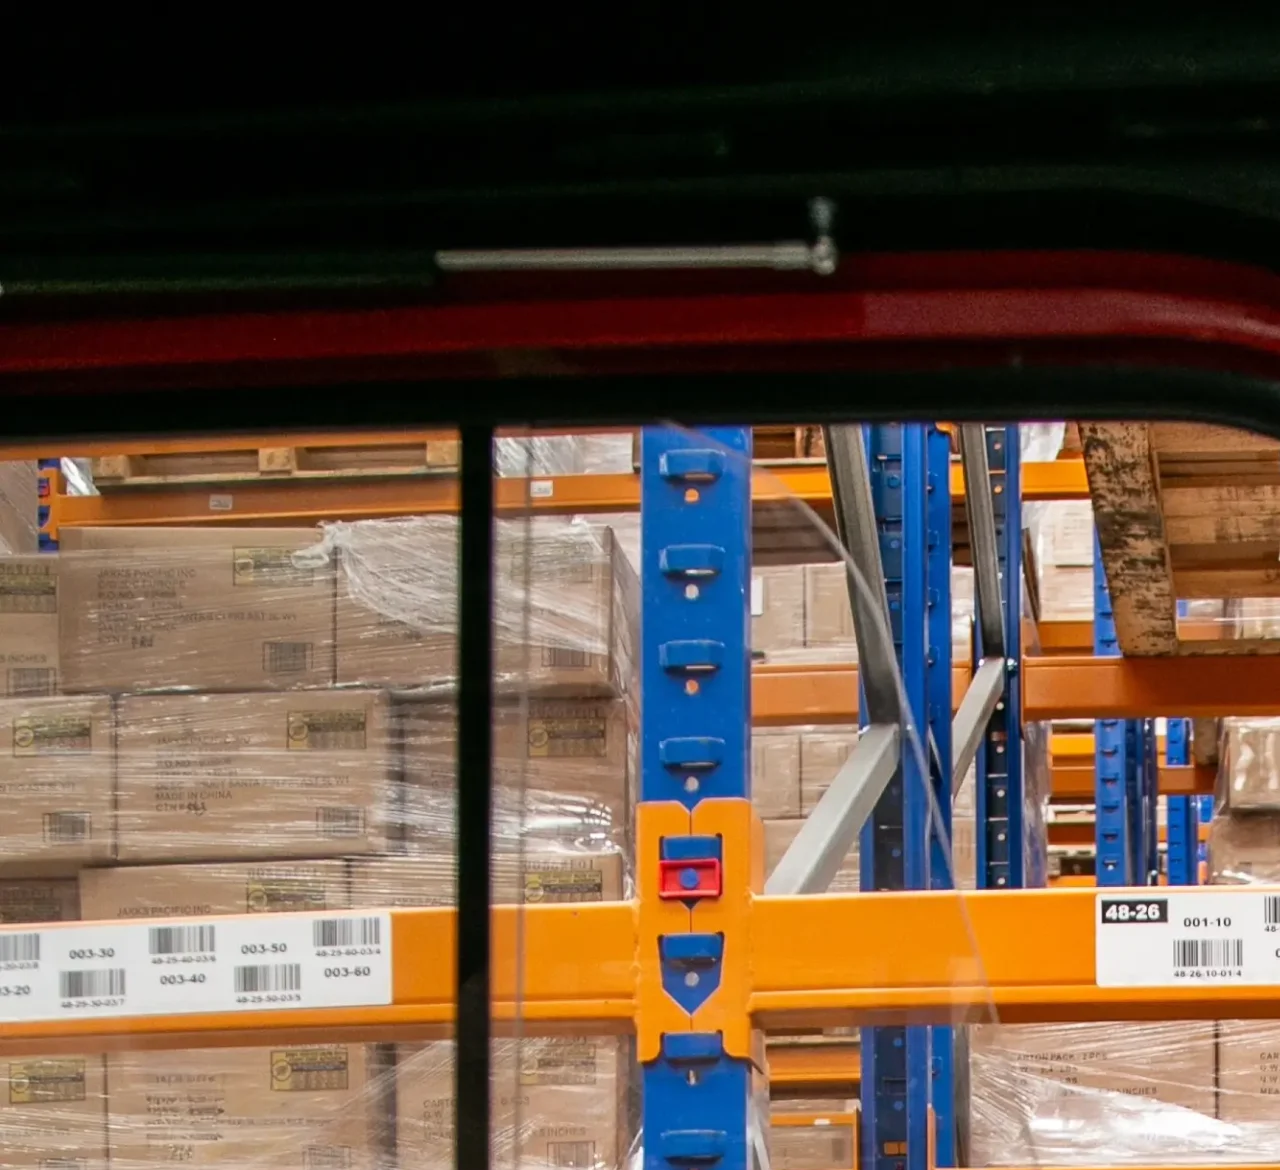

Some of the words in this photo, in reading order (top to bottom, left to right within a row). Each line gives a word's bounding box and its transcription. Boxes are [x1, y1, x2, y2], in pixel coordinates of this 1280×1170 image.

[1105, 904, 1160, 920] 48-26
[1183, 917, 1232, 927] 001-10
[69, 948, 115, 959] 003-30
[241, 943, 287, 954] 003-50
[324, 966, 371, 978] 003-60
[160, 973, 206, 985] 003-40
[0, 985, 31, 996] 3-20
